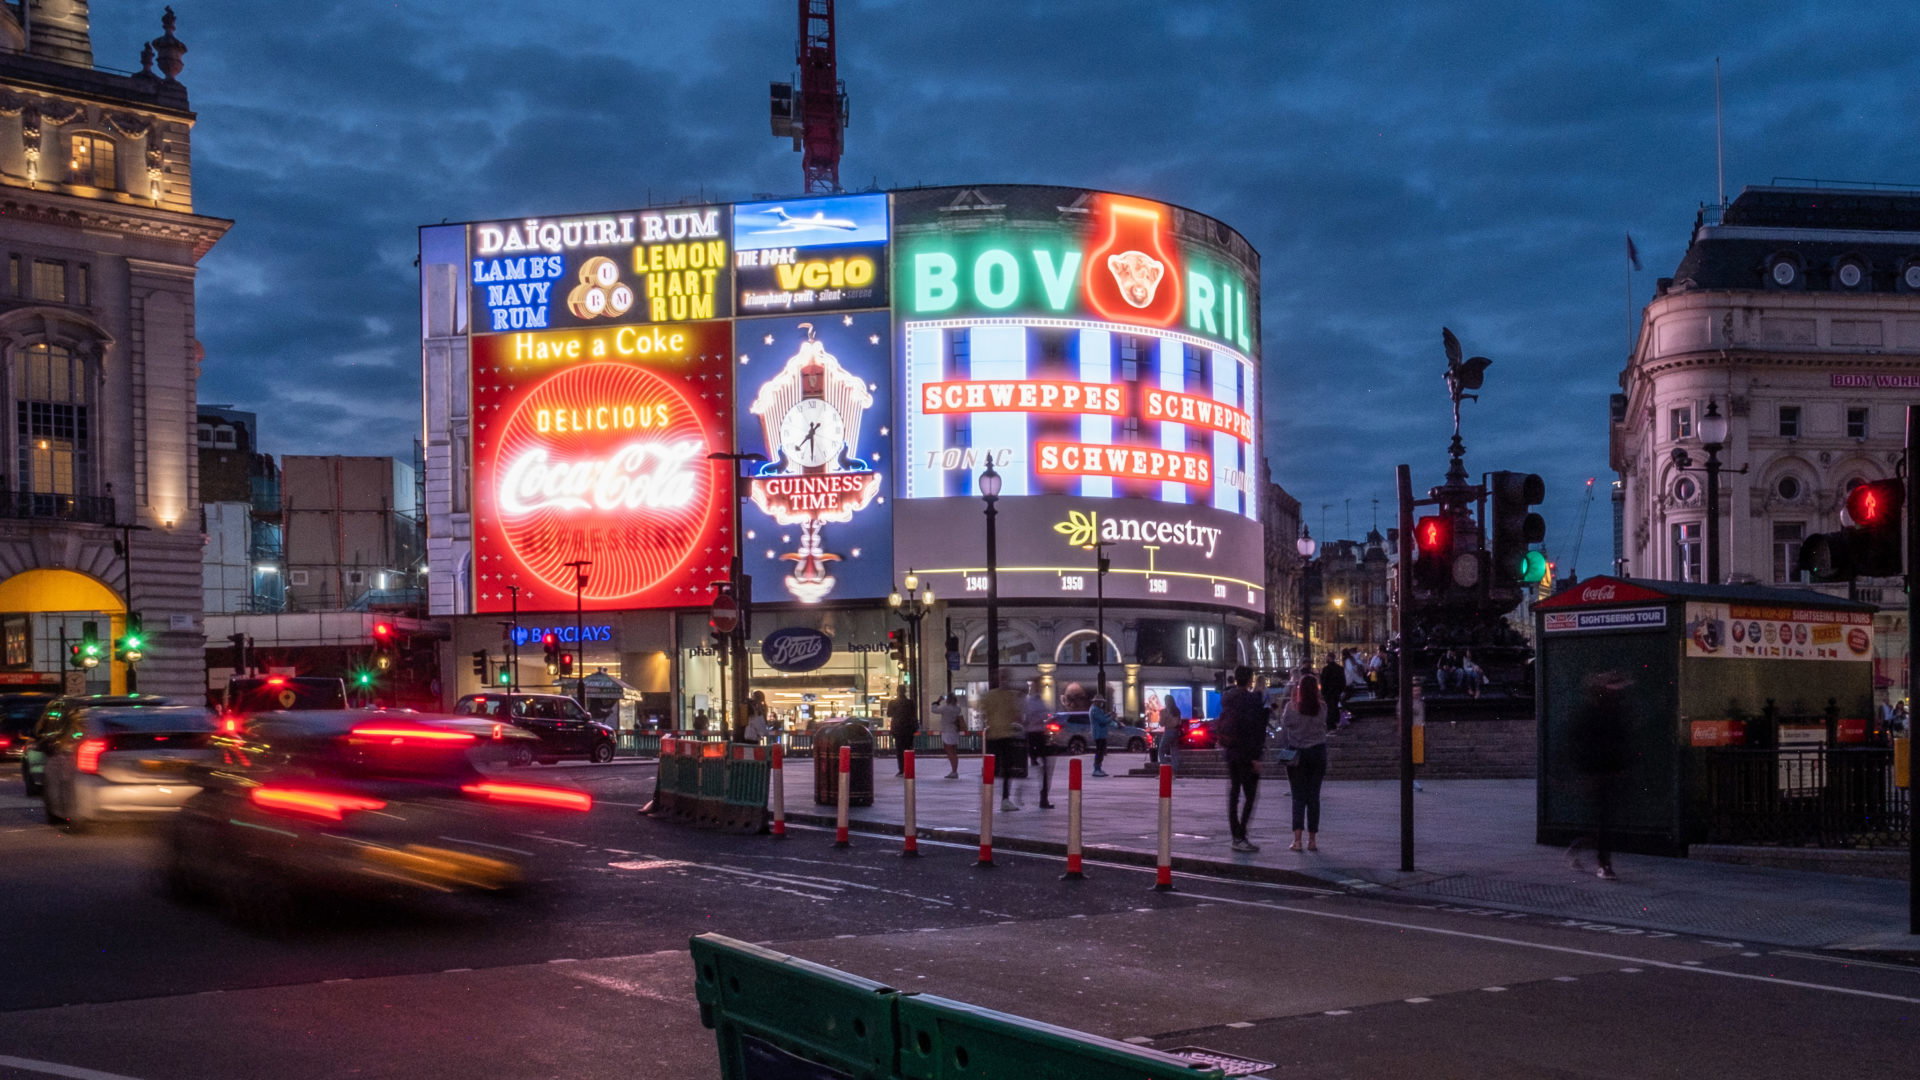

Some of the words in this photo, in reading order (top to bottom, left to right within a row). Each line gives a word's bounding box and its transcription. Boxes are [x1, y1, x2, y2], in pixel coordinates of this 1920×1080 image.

[480, 217, 635, 254] DAÏQUIRI
[642, 212, 719, 241] RUM
[473, 255, 563, 282] LAMB'S
[636, 241, 725, 273] LEMON
[737, 250, 759, 266] THE
[648, 268, 717, 298] HART
[777, 259, 873, 290] VC10
[488, 281, 550, 307] NAVY
[744, 291, 793, 308] Triumphantly
[793, 289, 814, 303] swift
[819, 288, 841, 302] silent
[847, 288, 873, 299] serene
[493, 306, 547, 330] RUM
[652, 295, 714, 322] RUM
[516, 334, 581, 361] Have
[592, 342, 607, 357] a
[616, 327, 685, 356] Coke
[1833, 374, 1872, 387] BODY
[926, 384, 1121, 412] SCHWEPPES
[537, 404, 669, 433] DELICIOUS
[1149, 392, 1251, 441] SCHWEPPES
[500, 441, 704, 514] Coca-Cola
[1041, 446, 1209, 482] SCHWEPPES
[767, 475, 863, 497] GUINNESS
[790, 494, 838, 511] TIME
[1101, 517, 1219, 558] ancestry
[966, 576, 988, 591] 1940
[1061, 576, 1083, 590] 1950
[1149, 579, 1168, 593] 1960
[1582, 585, 1616, 601] Coca-Cola
[1581, 613, 1635, 625] SIGHTSEEING
[1637, 611, 1660, 621] TOUR
[1792, 609, 1835, 622] SIGHTSEEING
[1835, 612, 1849, 623] BUS
[1849, 612, 1871, 624] TOURS
[531, 626, 611, 642] BARCLAYS
[1187, 626, 1216, 660] GAP
[769, 635, 822, 665] Boots
[848, 641, 892, 655] beauty
